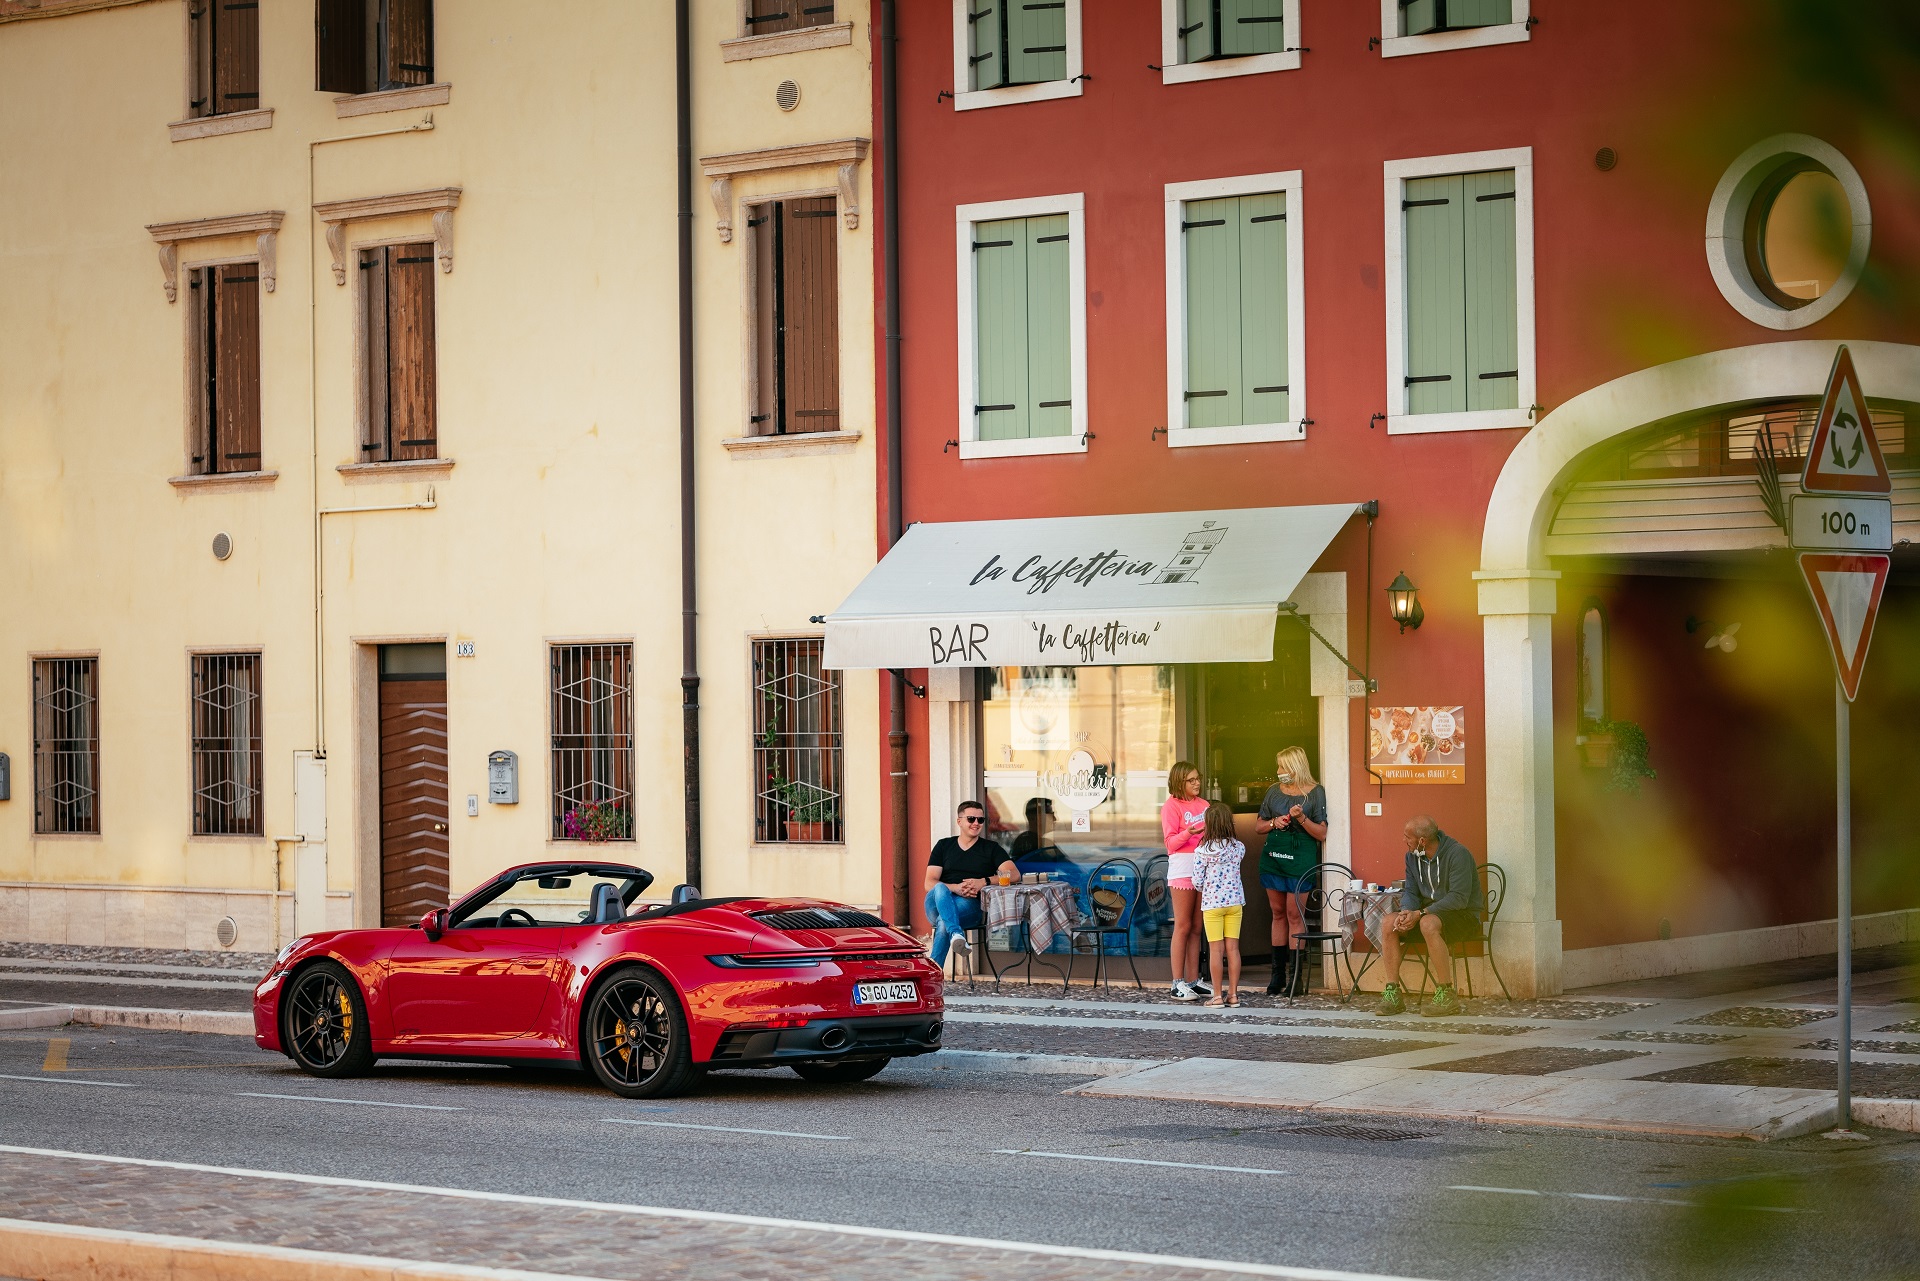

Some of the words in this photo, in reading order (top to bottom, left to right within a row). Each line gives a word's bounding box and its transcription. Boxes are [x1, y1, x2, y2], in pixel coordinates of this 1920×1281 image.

[1821, 511, 1856, 534] 100
[1860, 523, 1870, 535] m
[969, 554, 1008, 586] la
[1011, 549, 1158, 595] Caffetteria
[457, 643, 474, 655] 183
[929, 623, 989, 665] BAR
[1043, 769, 1119, 796] Caffetteria
[1272, 851, 1294, 860] Heineken
[860, 986, 868, 1001] S
[873, 985, 888, 1000] GO
[889, 984, 915, 1000] 4252
